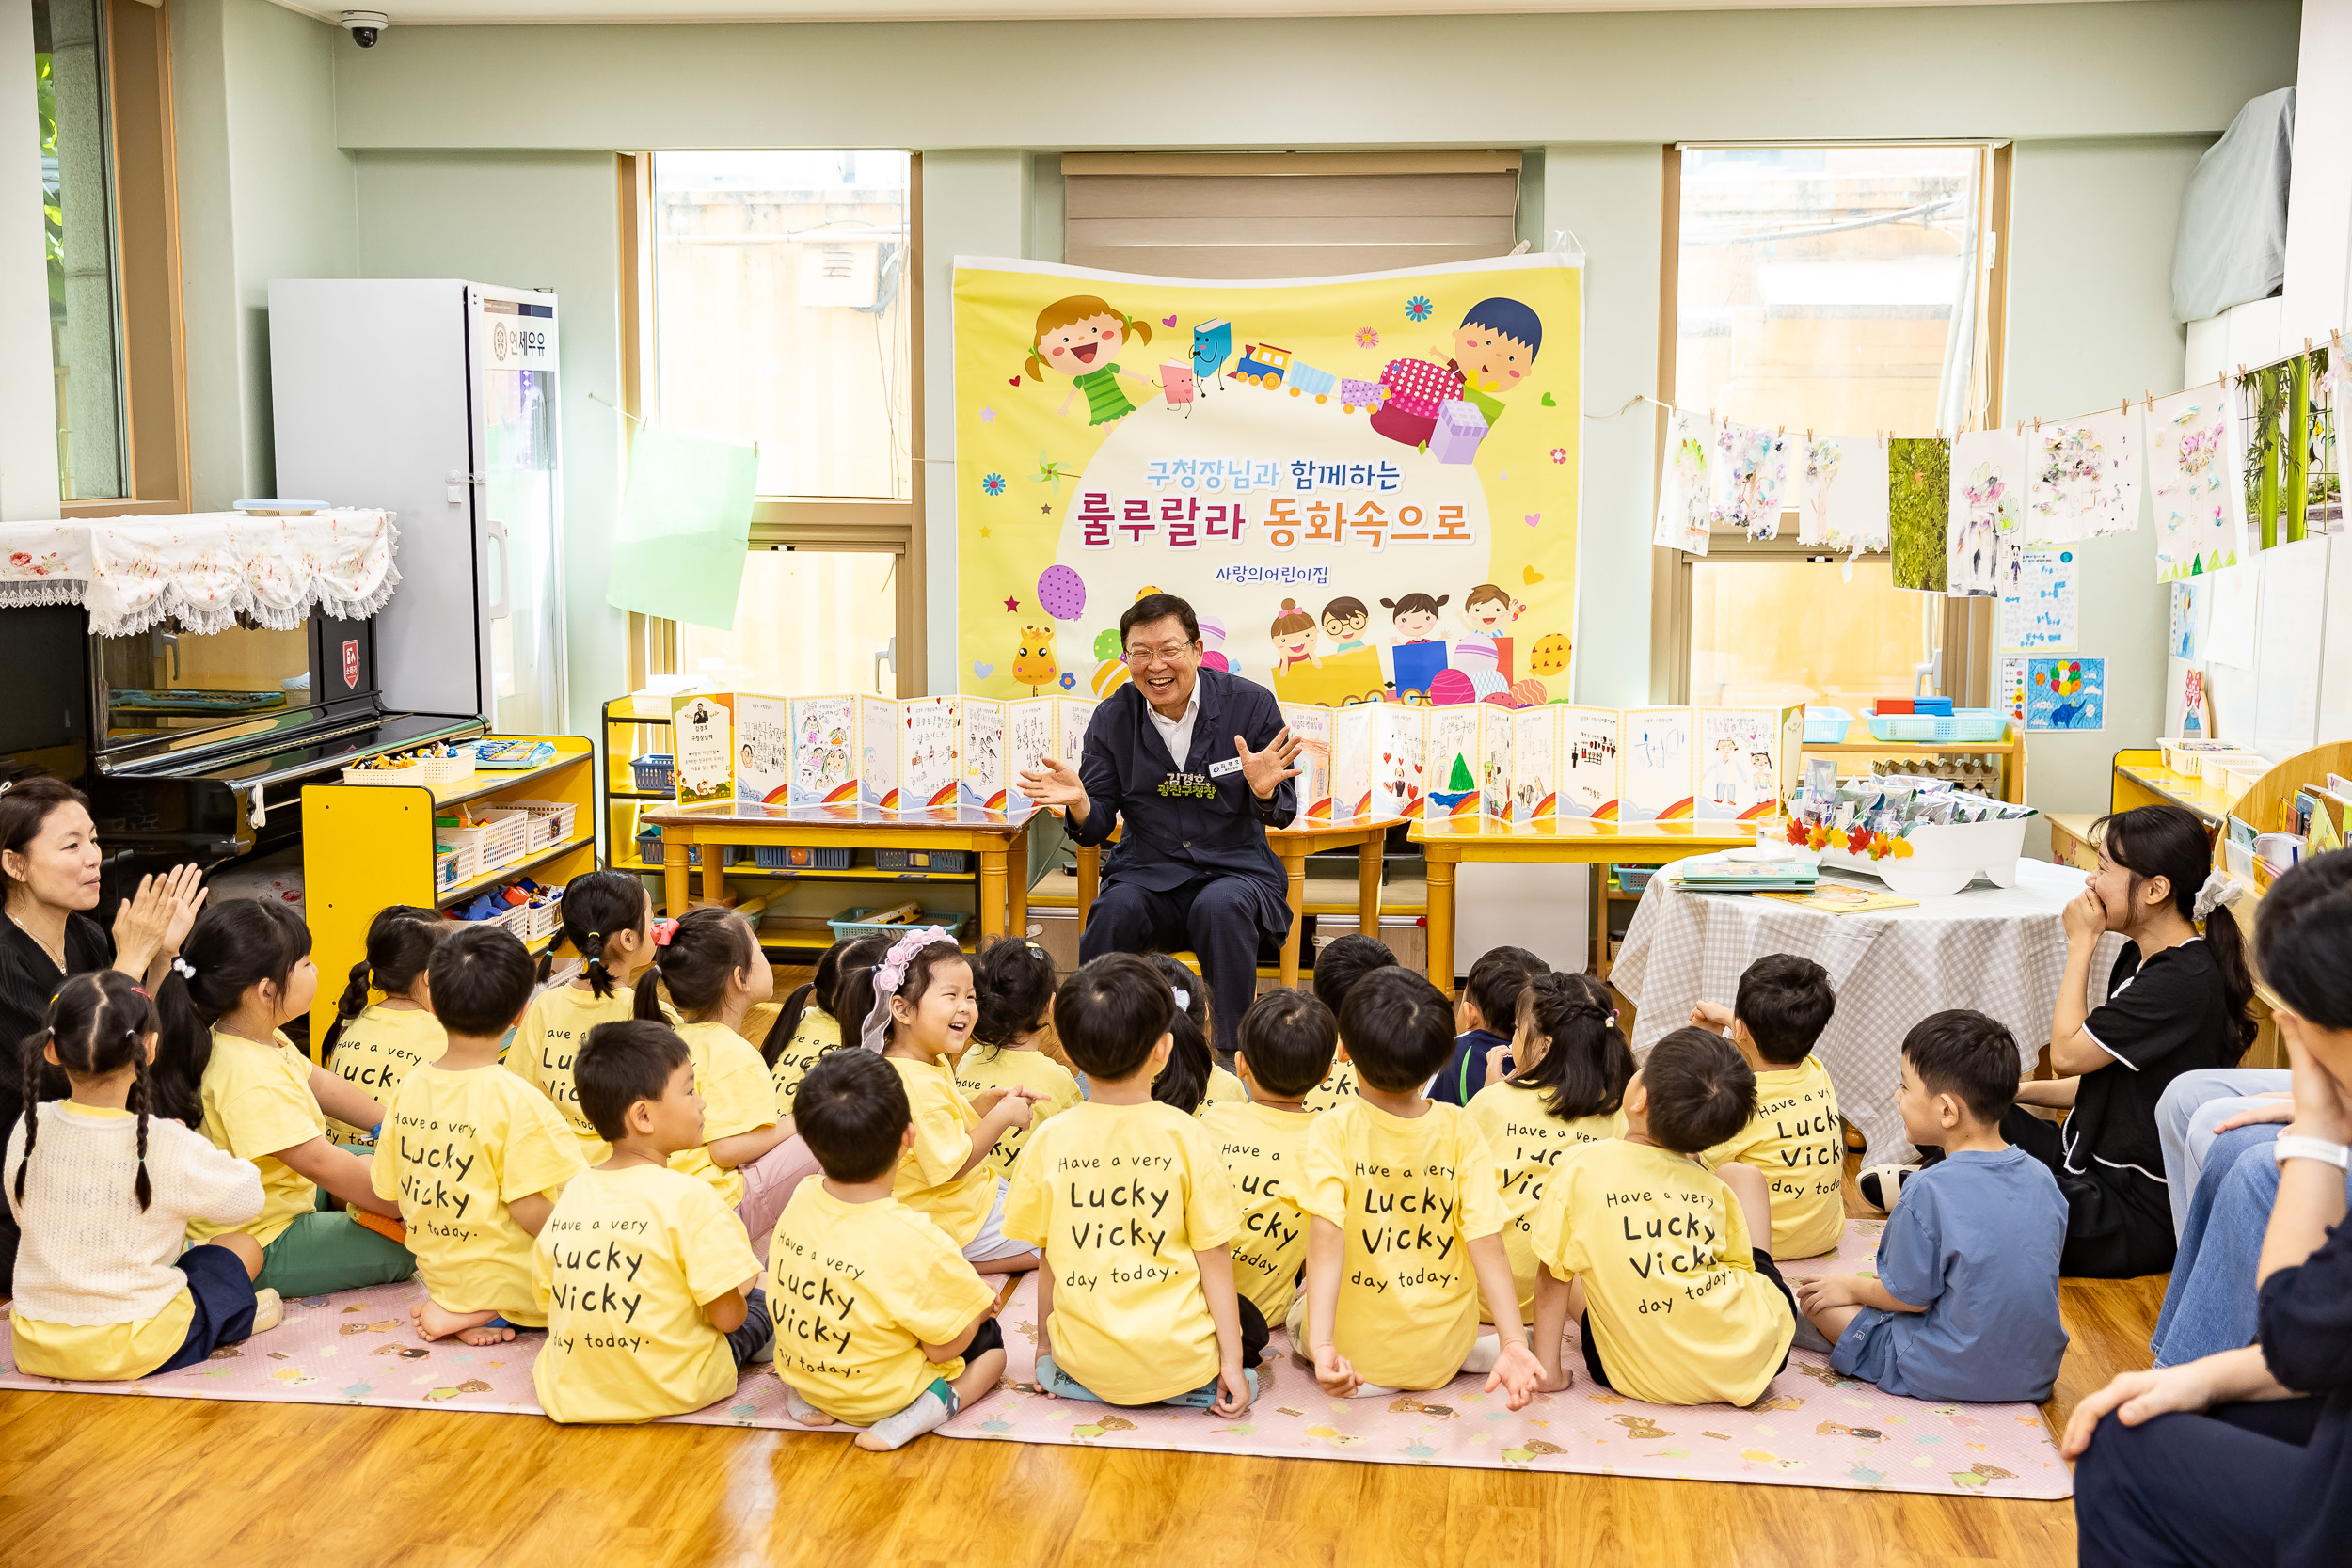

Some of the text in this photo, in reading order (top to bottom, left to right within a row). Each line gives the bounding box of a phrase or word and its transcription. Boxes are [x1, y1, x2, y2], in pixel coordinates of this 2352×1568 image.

[509, 330, 545, 356] 연세우유
[1146, 459, 1400, 490] 구청장님과 함께하는
[1077, 492, 1471, 548] 룰루랄라 동화속으로
[1216, 565, 1330, 585] 사랑의어린이집
[1157, 784, 1217, 800] 광진구청장
[1167, 773, 1206, 786] 김경호
[548, 1029, 571, 1039] ave
[388, 1048, 421, 1066] very
[543, 1047, 572, 1070] Lu
[778, 1053, 814, 1069] uc
[335, 1058, 401, 1087] Luck
[955, 1076, 980, 1089] Have
[542, 1080, 580, 1102] Vic
[1758, 1099, 1797, 1119] Have
[1804, 1094, 1812, 1102] a
[326, 1128, 339, 1145] ay
[430, 1121, 438, 1130] a
[449, 1123, 476, 1138] very
[1507, 1123, 1547, 1138] Have
[401, 1136, 474, 1181] Lucky
[1222, 1144, 1260, 1157] Have
[1781, 1138, 1844, 1167] Vick
[1059, 1157, 1172, 1172] Have a very
[1355, 1162, 1455, 1181] Have a very
[401, 1174, 469, 1219] Vicky
[1503, 1168, 1543, 1200] Vic
[1772, 1180, 1804, 1199] day
[1071, 1178, 1168, 1219] Lucky
[1364, 1187, 1454, 1223] Lucky
[1607, 1192, 1652, 1208] Have
[1681, 1193, 1714, 1210] very
[427, 1220, 478, 1242] today.
[551, 1219, 648, 1235] Have a very
[1072, 1218, 1166, 1257] Vicky
[1245, 1210, 1298, 1251] cky
[1624, 1212, 1716, 1245] Lucky
[1362, 1223, 1454, 1260] Vicky
[553, 1242, 642, 1282] Lucky
[778, 1229, 864, 1281] Have a very
[1232, 1246, 1279, 1275] today.
[777, 1259, 854, 1321] Lucky
[1067, 1264, 1178, 1292] day today.
[1351, 1268, 1458, 1294] day today.
[552, 1282, 642, 1324] Vicky
[1639, 1270, 1731, 1314] day today.
[773, 1298, 850, 1354] Vicky
[554, 1330, 650, 1354] day today.
[800, 1356, 860, 1378] today.
